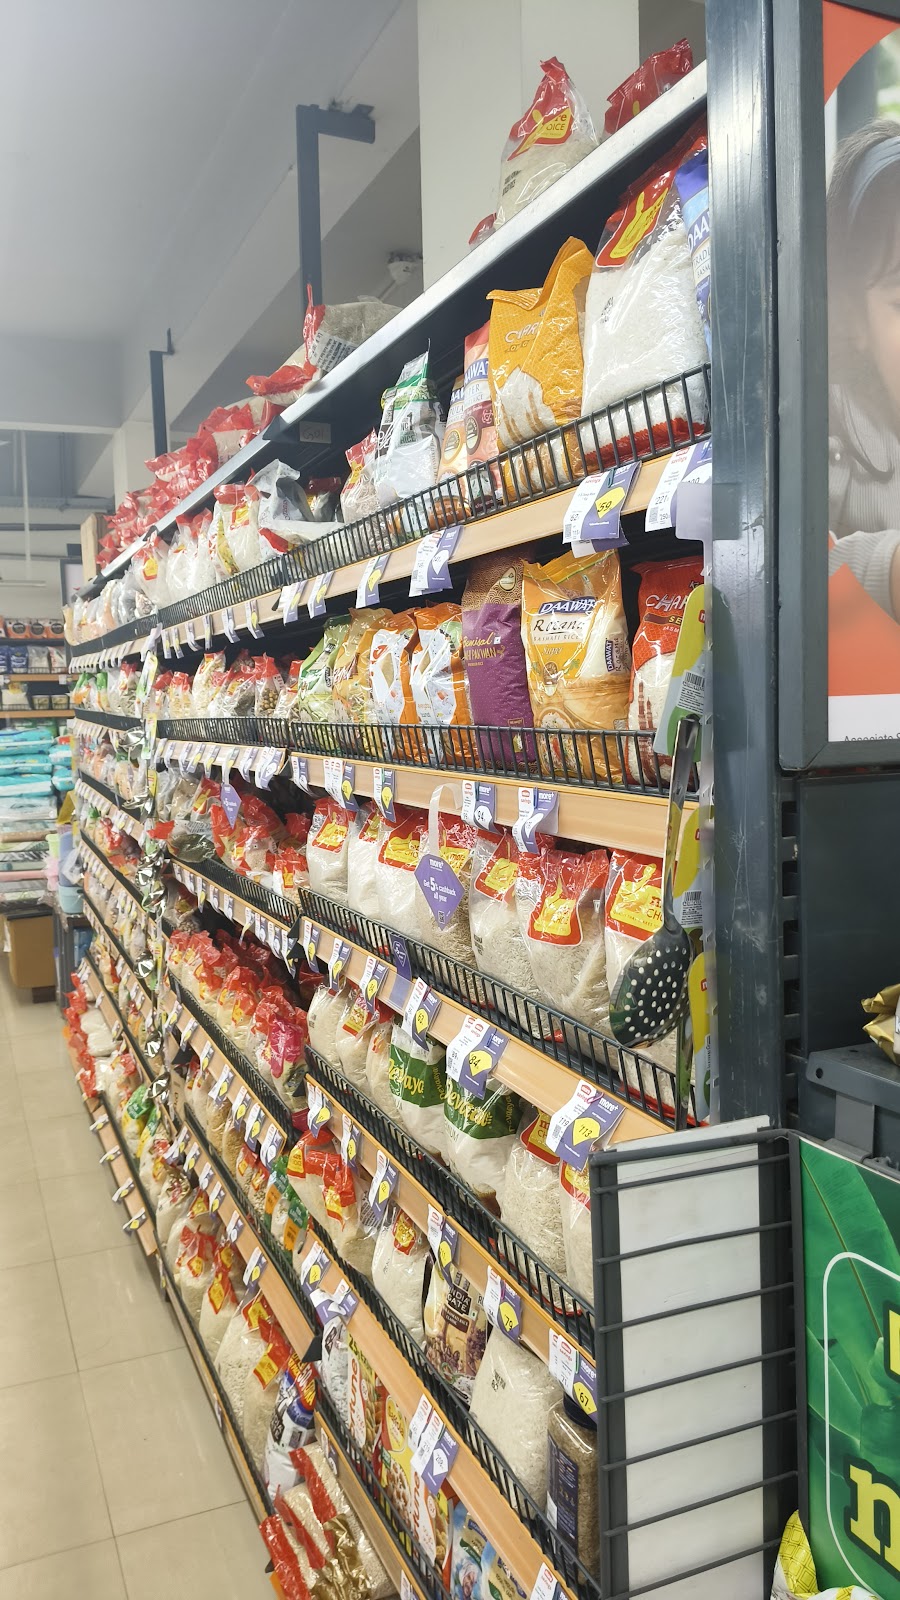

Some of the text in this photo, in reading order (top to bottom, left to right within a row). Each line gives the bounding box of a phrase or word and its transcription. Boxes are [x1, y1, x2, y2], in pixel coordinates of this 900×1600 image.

[541, 598, 596, 613] DAAWAT
[605, 640, 614, 671] DAAWAT
[599, 1097, 619, 1112] more+
[447, 1293, 467, 1312] GATE
